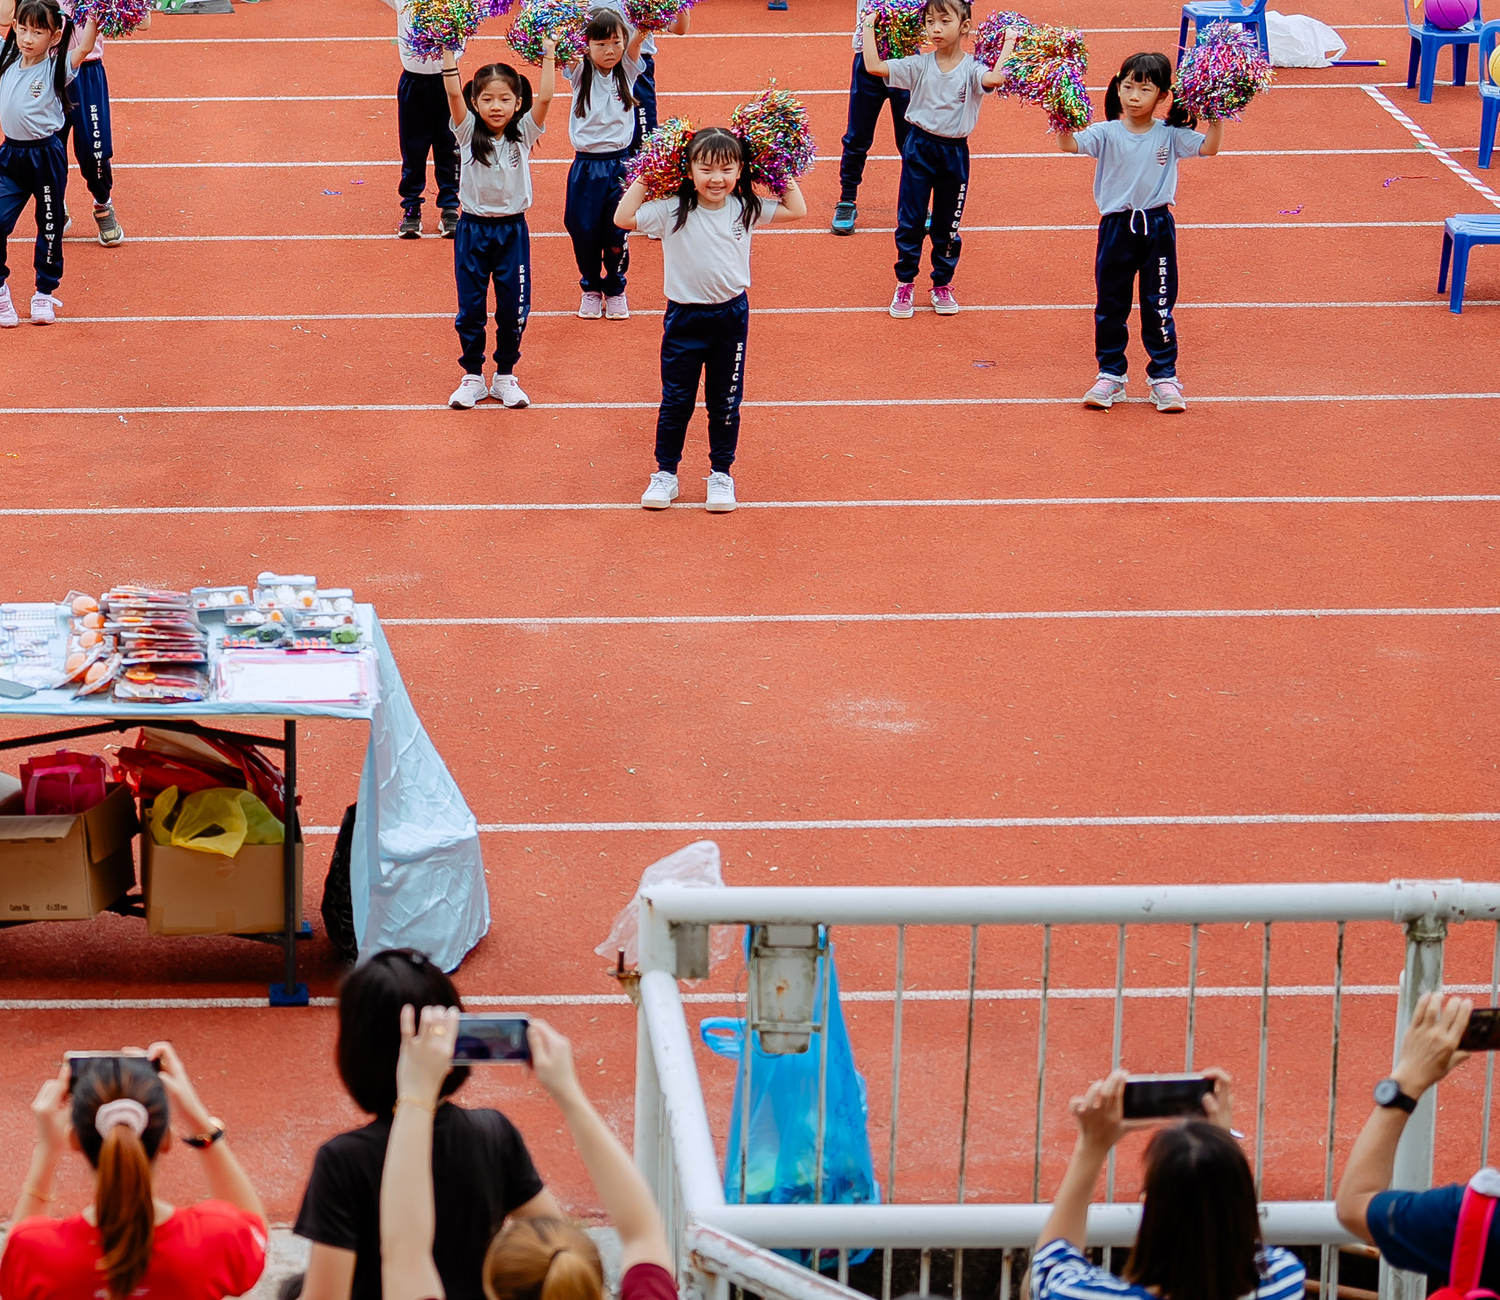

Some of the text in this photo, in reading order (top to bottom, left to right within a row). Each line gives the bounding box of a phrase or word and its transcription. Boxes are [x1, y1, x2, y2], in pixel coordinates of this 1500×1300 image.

[90, 104, 100, 138] ERIC
[43, 185, 53, 220] ERIC
[954, 183, 966, 218] ERIC
[45, 233, 56, 265] WILL
[1158, 256, 1167, 295] ERIC
[1157, 307, 1170, 343] WILL
[731, 342, 744, 381] ERIC
